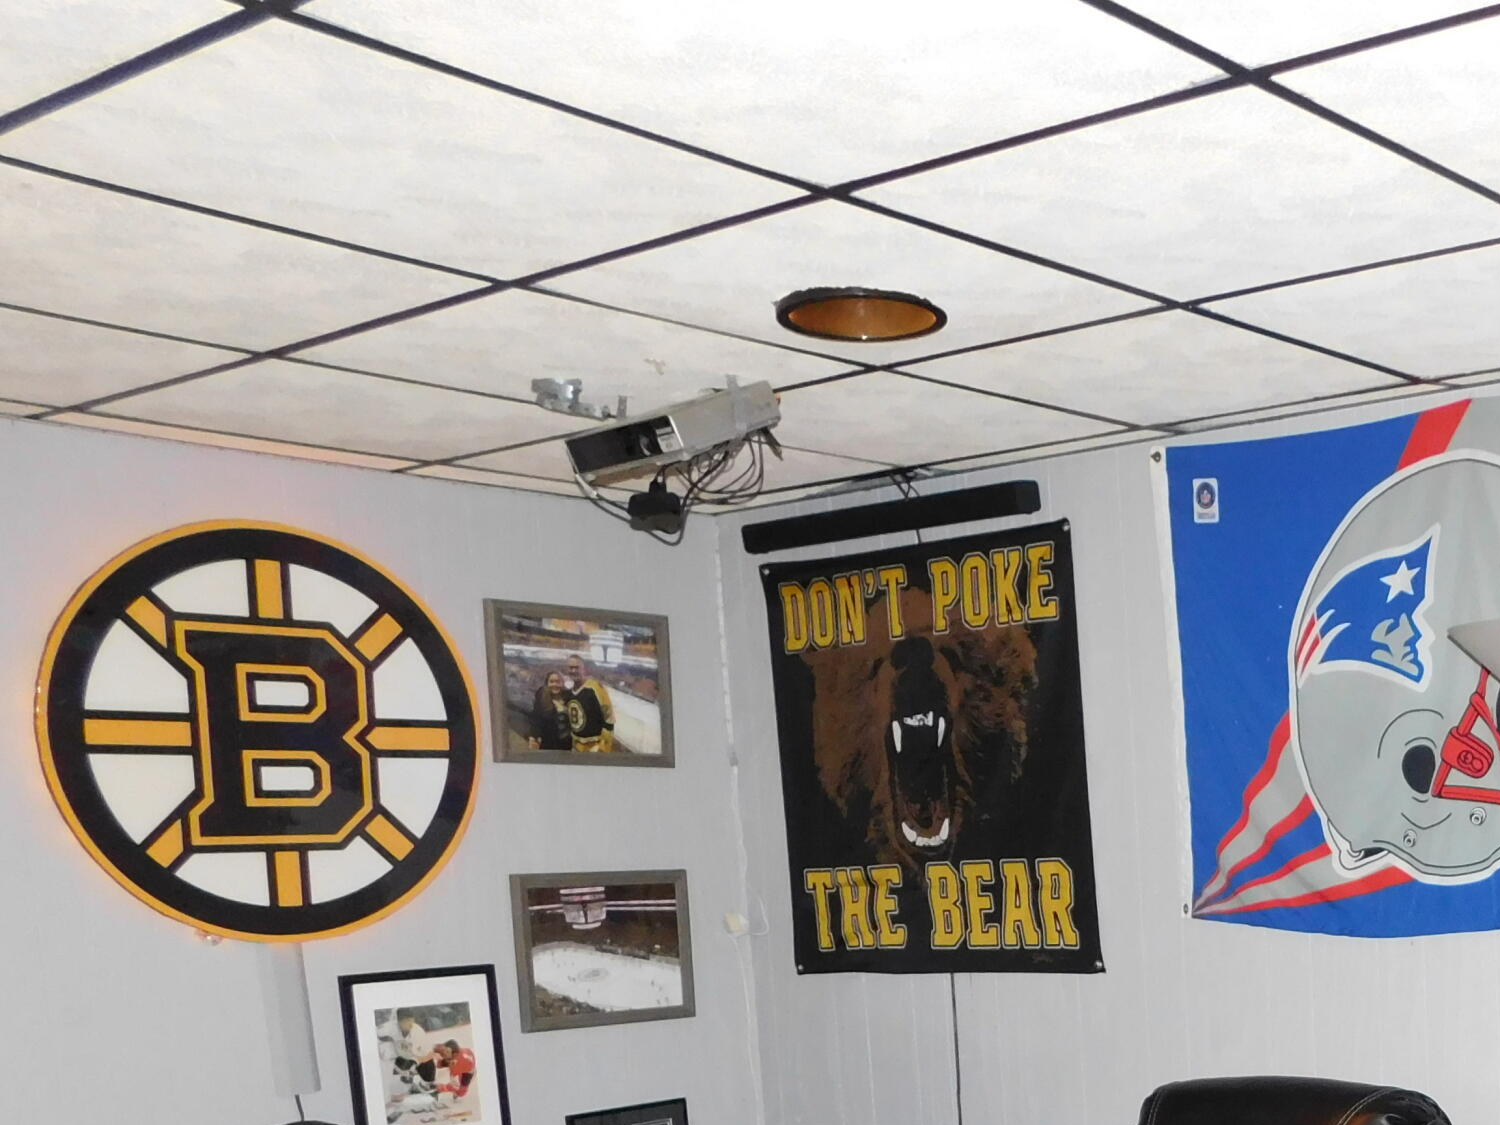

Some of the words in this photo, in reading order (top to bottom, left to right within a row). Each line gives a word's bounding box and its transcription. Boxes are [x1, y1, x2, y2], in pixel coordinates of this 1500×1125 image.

[779, 564, 906, 652] DON'T
[928, 541, 1060, 634] POKE
[174, 618, 374, 846] B
[804, 865, 907, 952] THE
[925, 857, 1080, 950] BEAR
